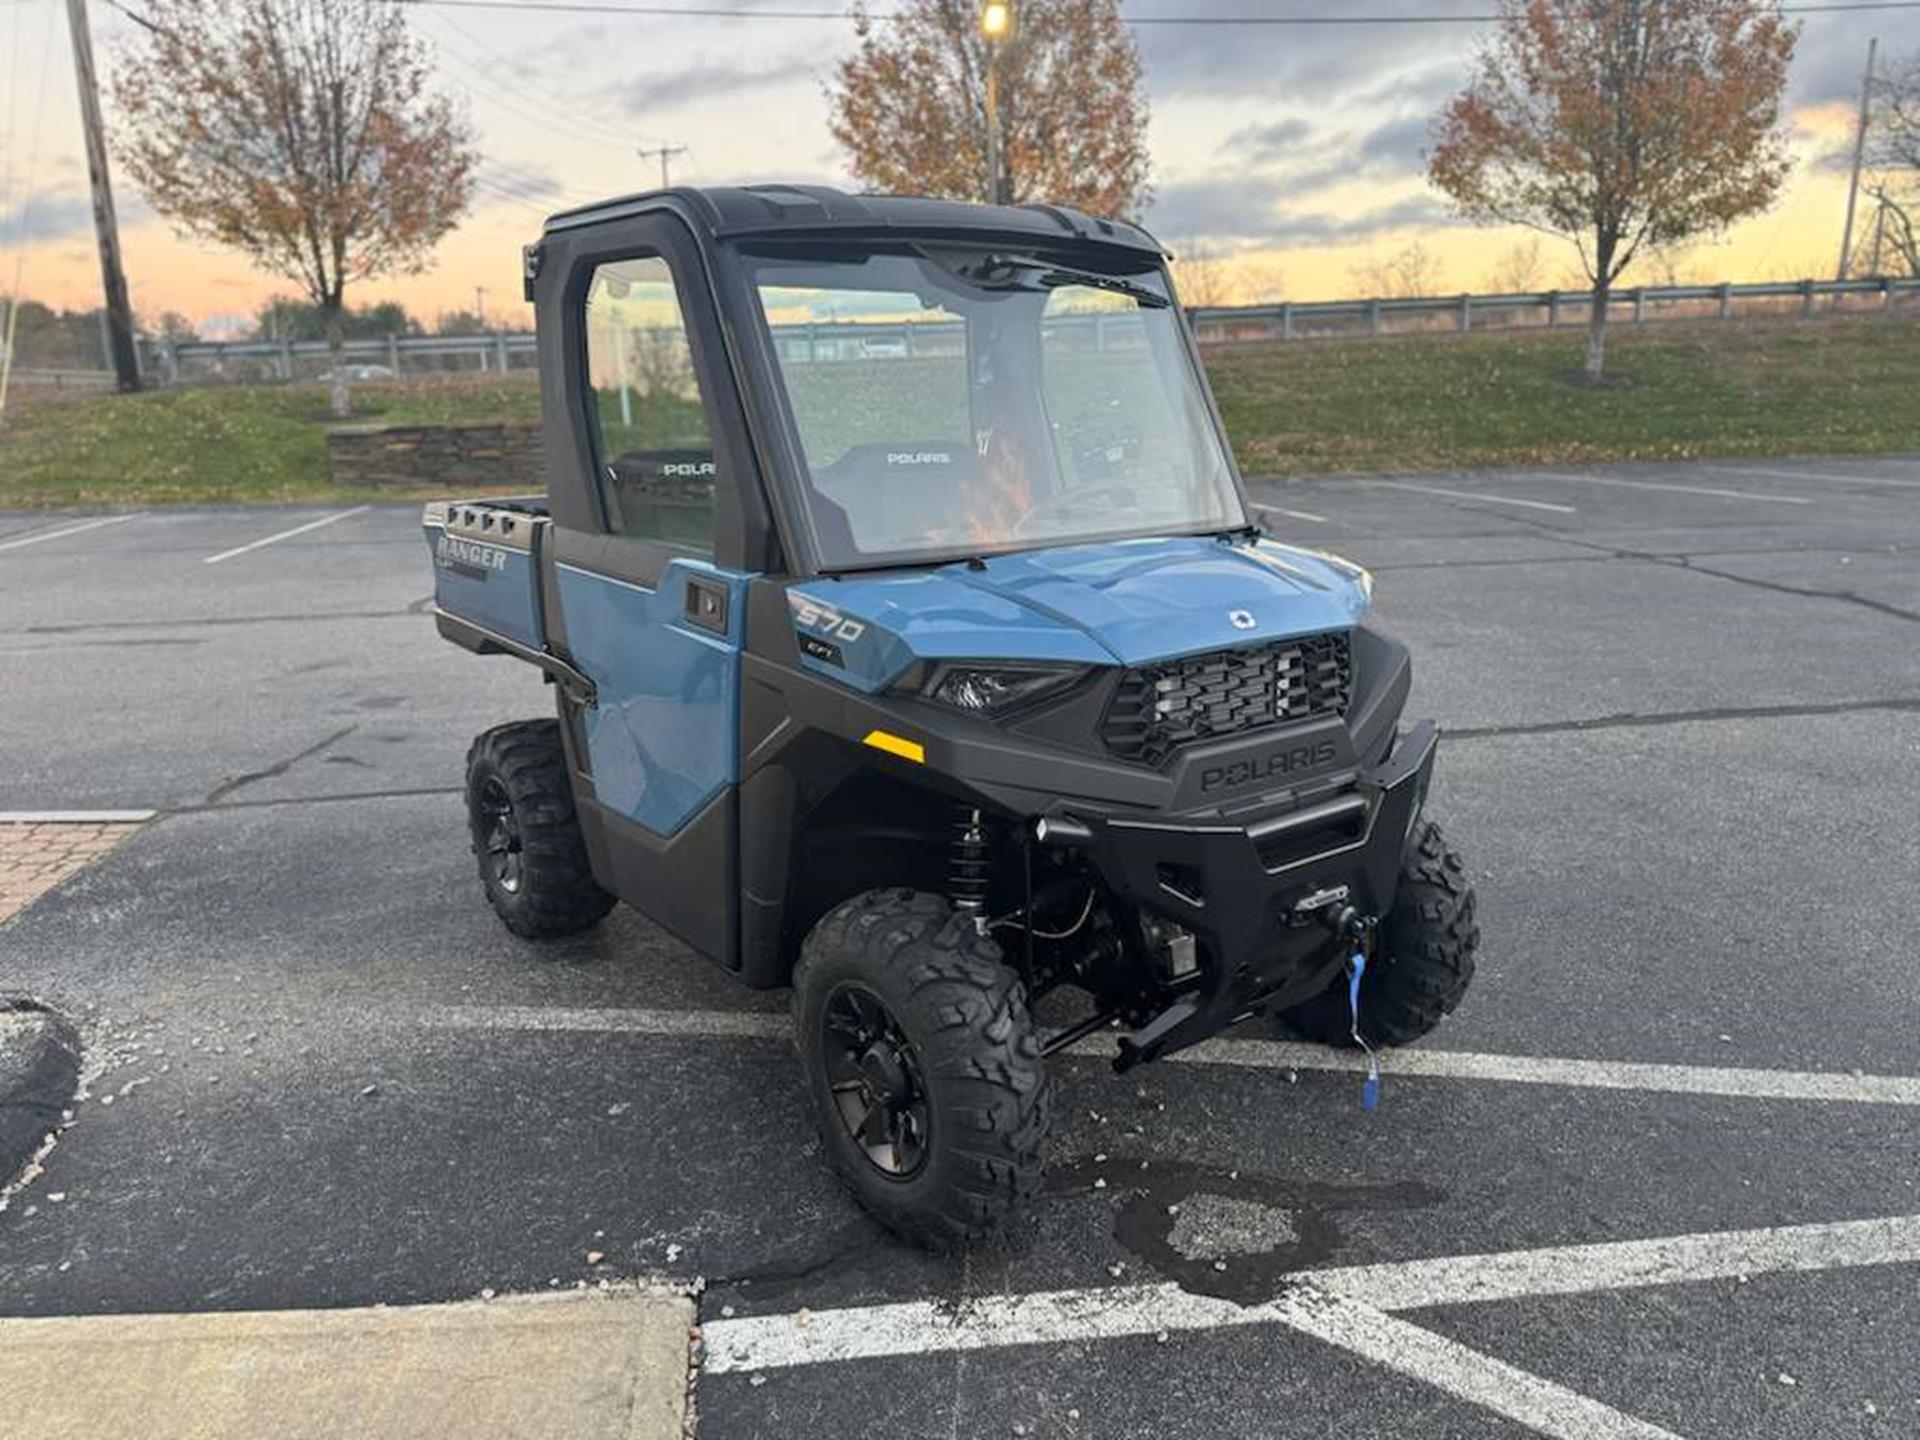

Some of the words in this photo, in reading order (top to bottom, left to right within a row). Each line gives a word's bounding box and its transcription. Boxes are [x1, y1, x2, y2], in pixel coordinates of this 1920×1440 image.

[437, 537, 507, 571] RANGER
[796, 606, 865, 642] 570
[1201, 740, 1336, 792] POLARIS
